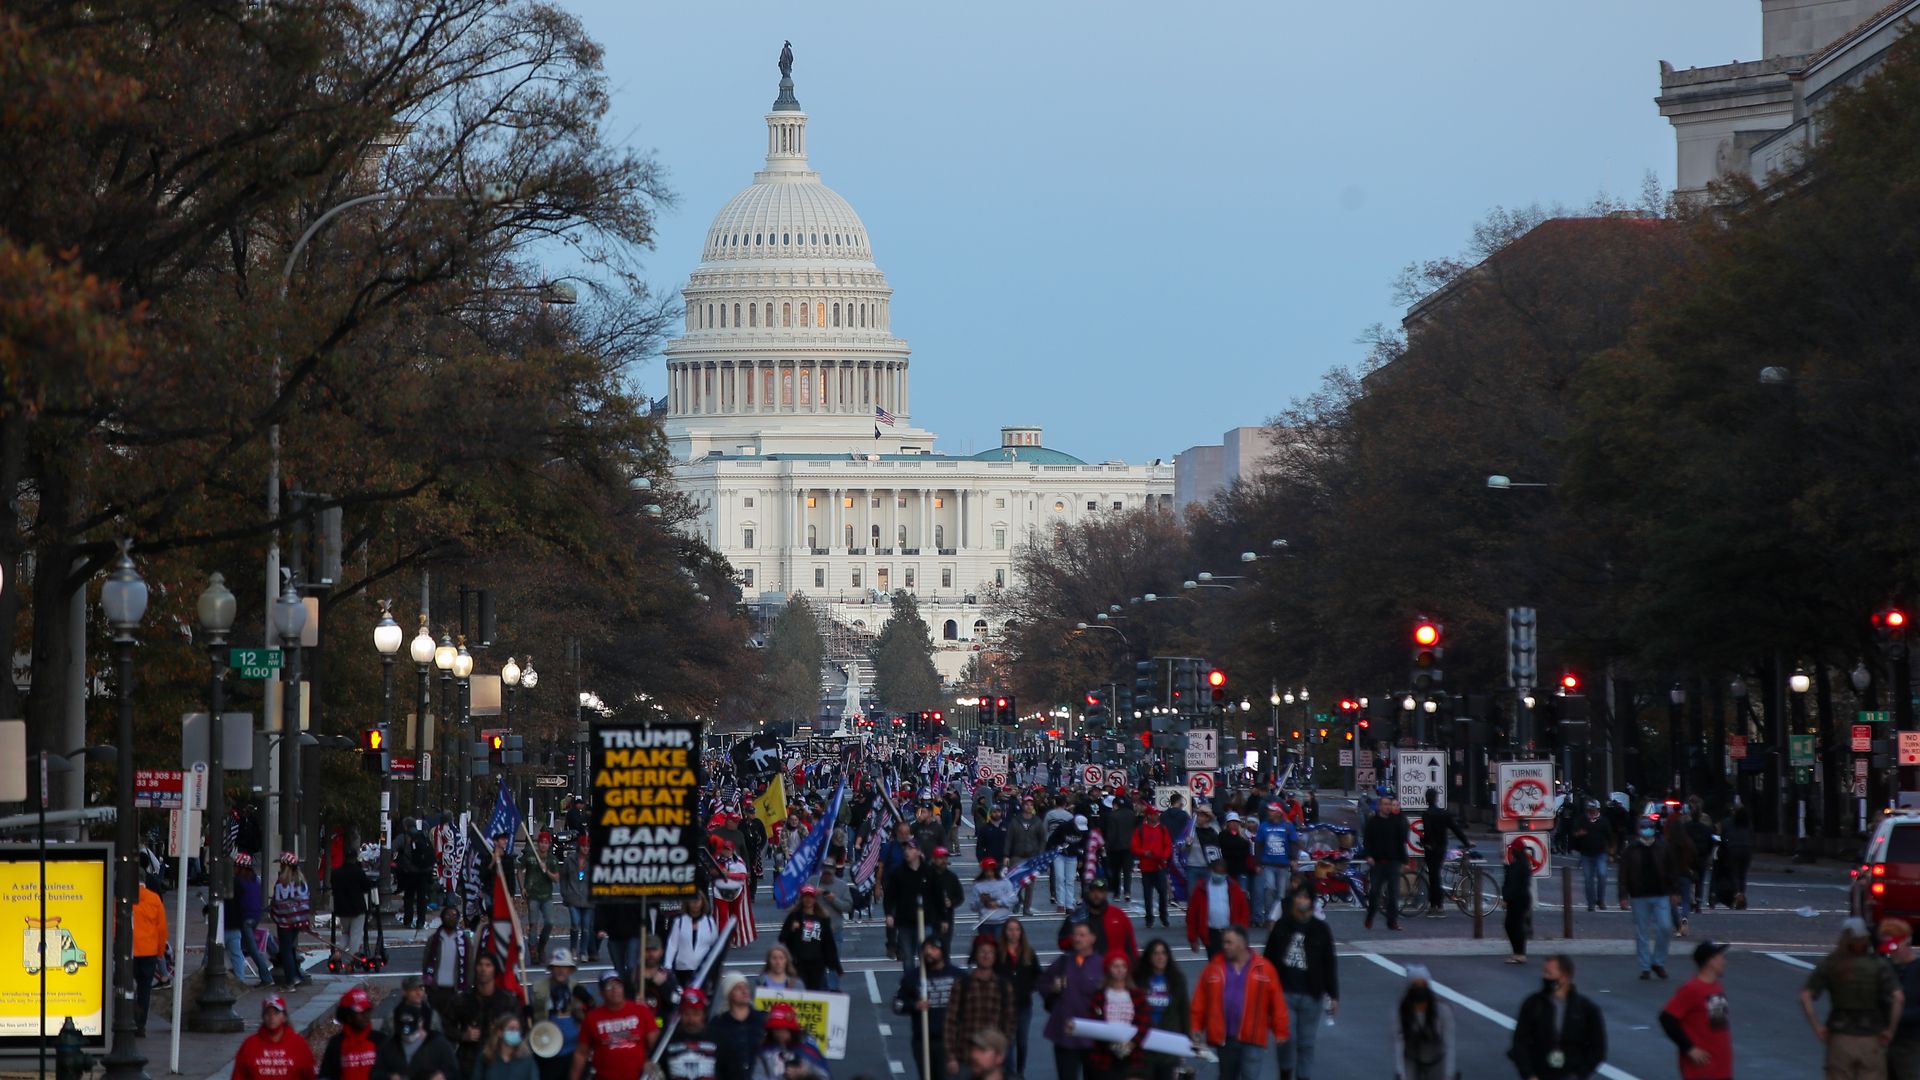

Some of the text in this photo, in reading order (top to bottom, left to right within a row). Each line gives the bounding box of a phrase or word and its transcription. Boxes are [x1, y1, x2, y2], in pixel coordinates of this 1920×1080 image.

[240, 652, 257, 666] 12
[244, 668, 269, 677] 400
[599, 729, 694, 750] TRUMP,
[605, 750, 688, 768] MAKE
[1402, 756, 1423, 764] THRU
[595, 769, 697, 787] AMERICA
[1512, 769, 1543, 777] TURNING
[604, 788, 688, 807] GREAT
[1402, 786, 1423, 794] OBEY
[601, 807, 691, 826] AGAIN:
[609, 826, 681, 846] BAN
[601, 846, 689, 865] HOMO
[592, 865, 696, 884] MARRIAGE
[43, 882, 74, 890] usiness
[12, 893, 32, 902] good
[596, 1014, 640, 1035] TRUMP
